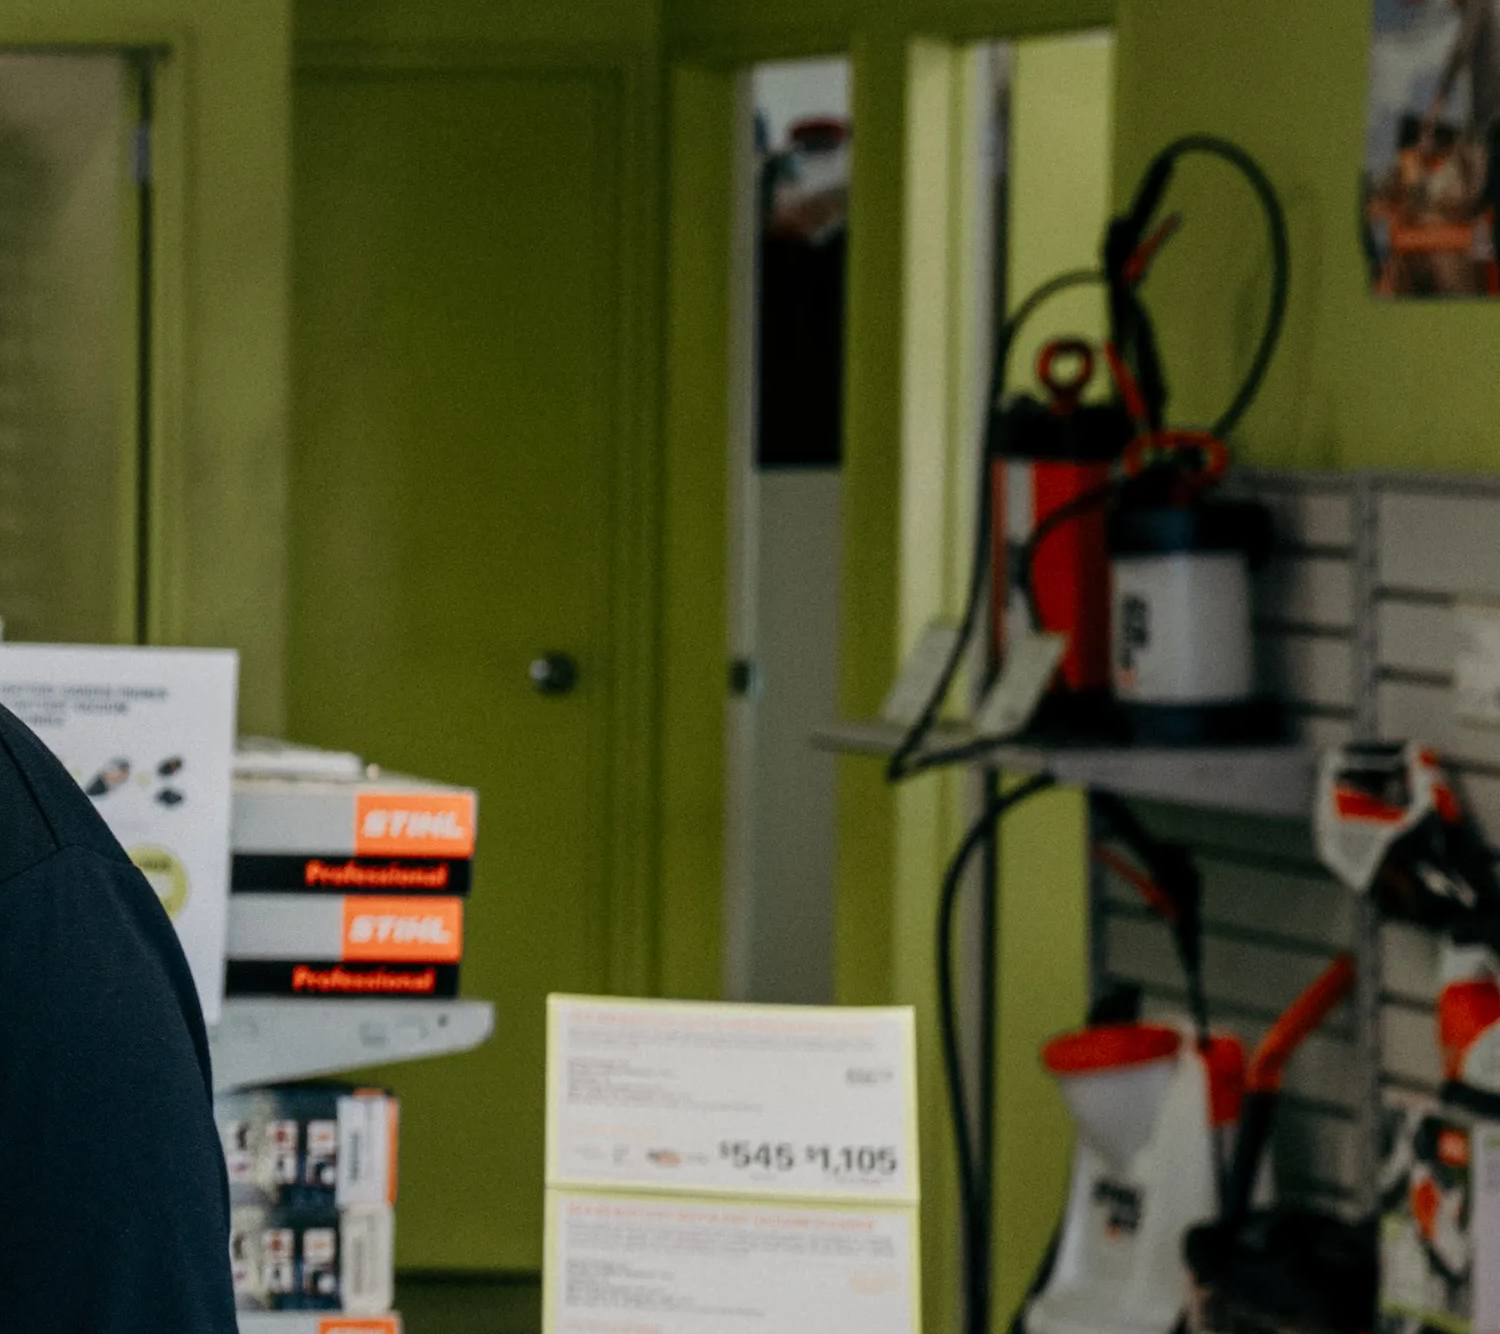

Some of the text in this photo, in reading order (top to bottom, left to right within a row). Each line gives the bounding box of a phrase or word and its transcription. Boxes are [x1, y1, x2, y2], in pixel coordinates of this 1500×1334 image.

[363, 809, 465, 839] STIHL
[304, 859, 449, 889] Professional
[349, 914, 453, 944] STIHL
[291, 965, 436, 994] Professional
[718, 1140, 897, 1176] $545 $1,105
